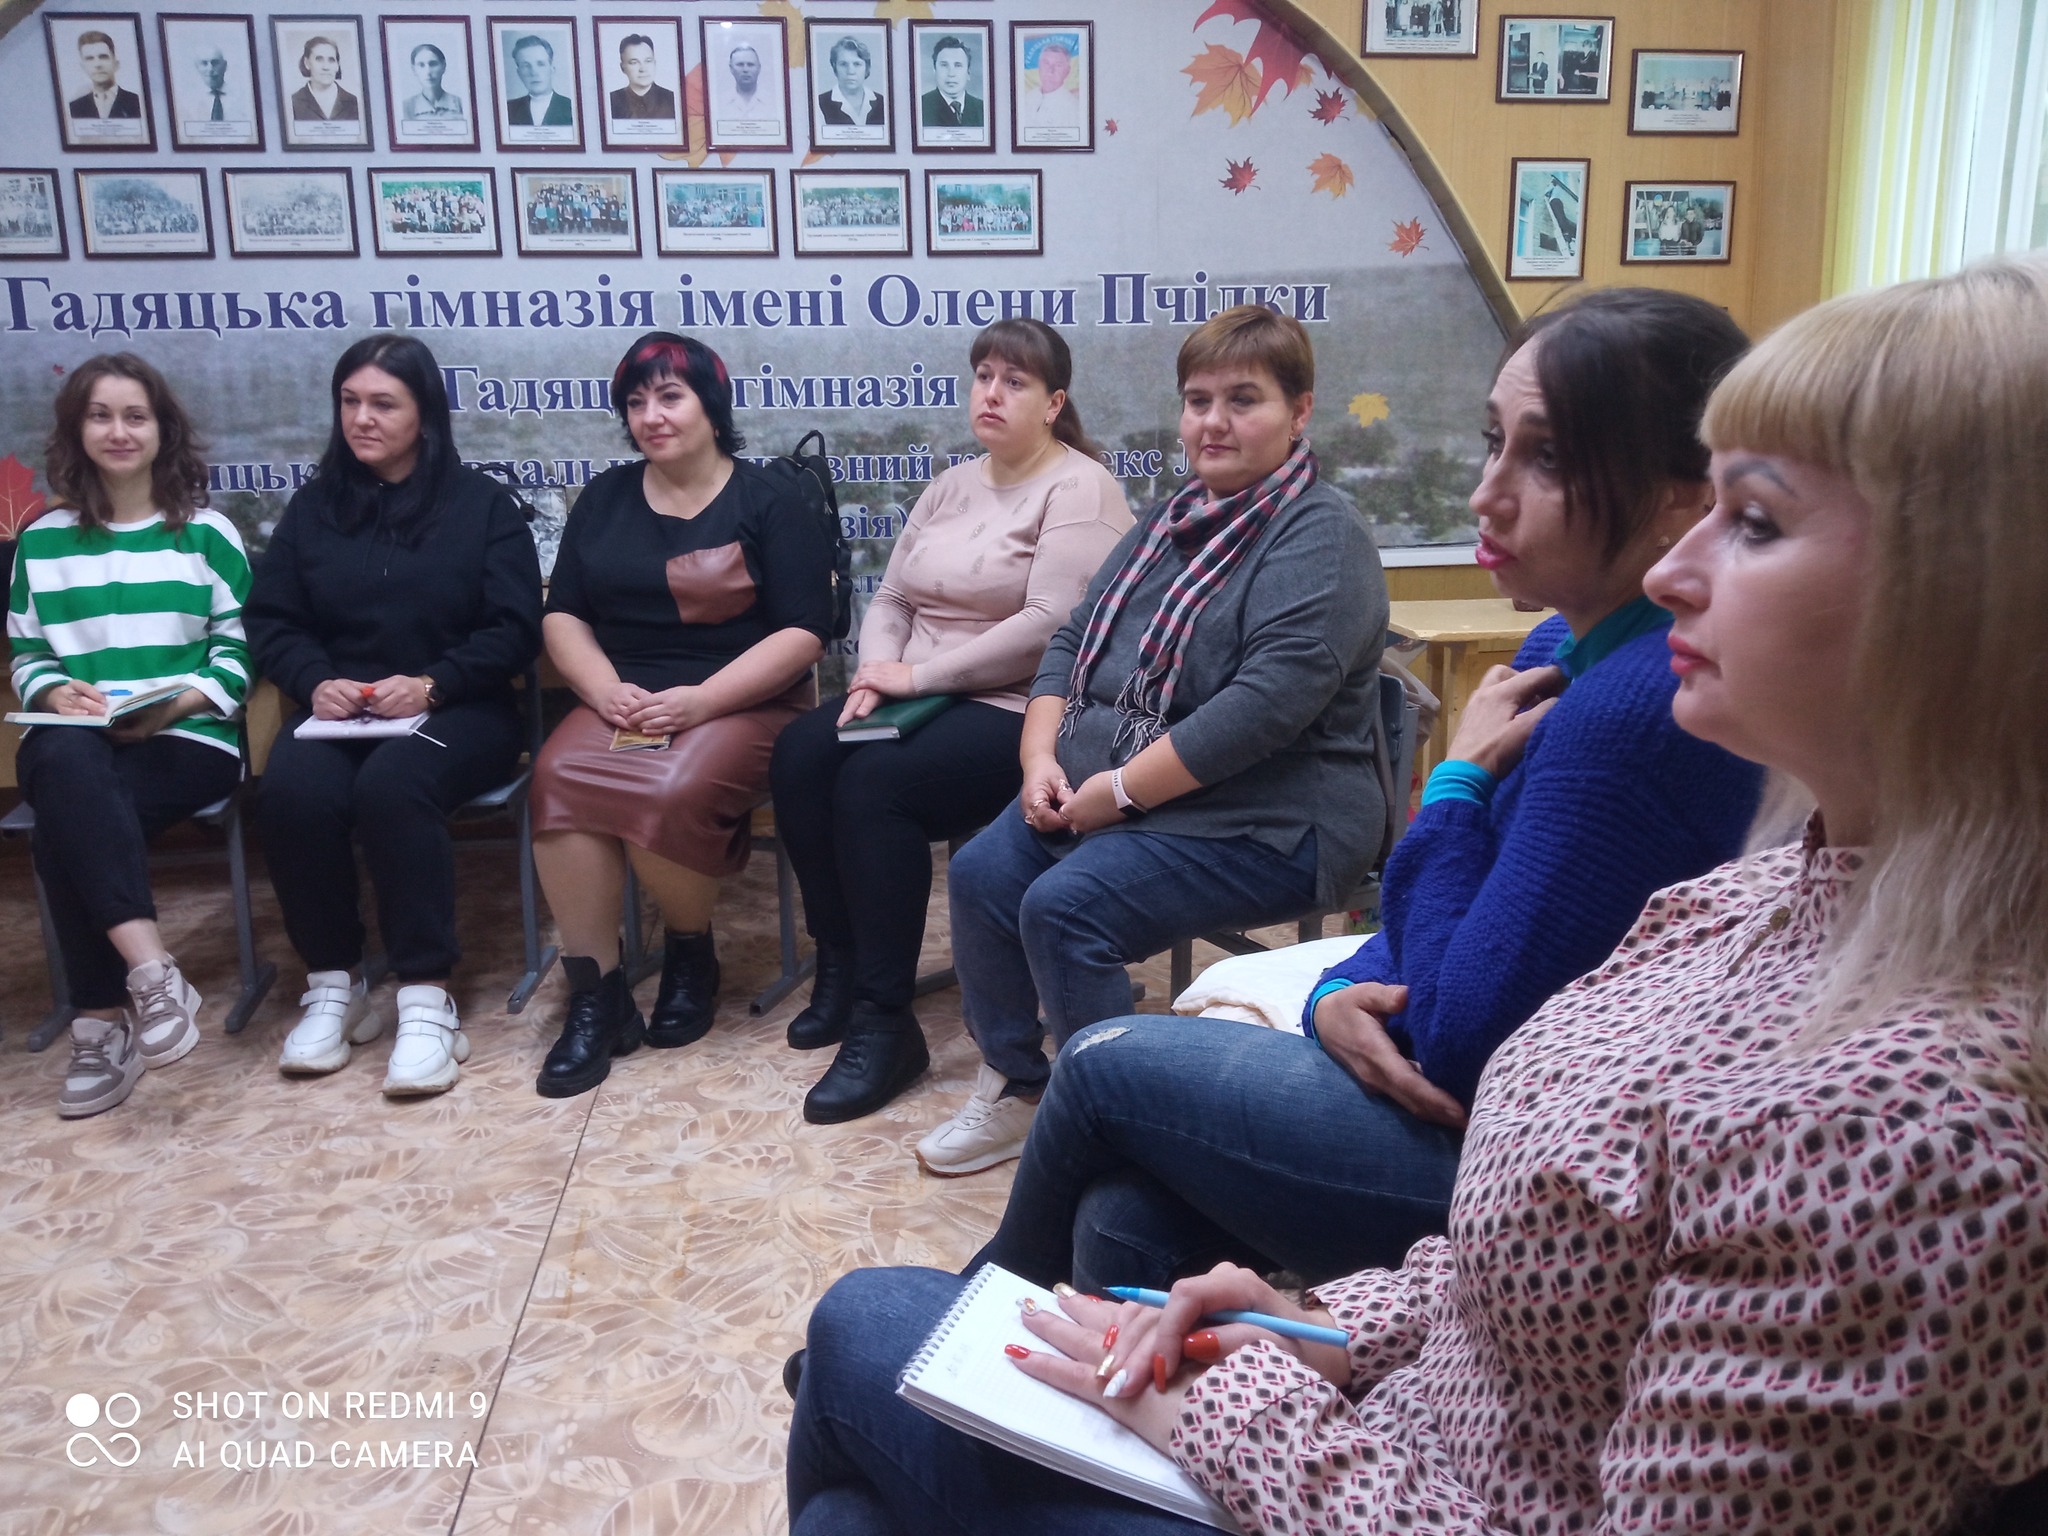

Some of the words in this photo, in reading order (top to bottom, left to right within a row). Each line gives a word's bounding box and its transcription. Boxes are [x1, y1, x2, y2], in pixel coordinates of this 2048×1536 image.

[1, 276, 349, 340] Гадяцька
[369, 273, 657, 328] гімназія
[677, 273, 848, 328] імені
[867, 273, 1077, 327] Олени
[1097, 270, 1330, 325] Пчілки
[439, 366, 616, 418] Гадяц
[732, 362, 960, 409] гімназія
